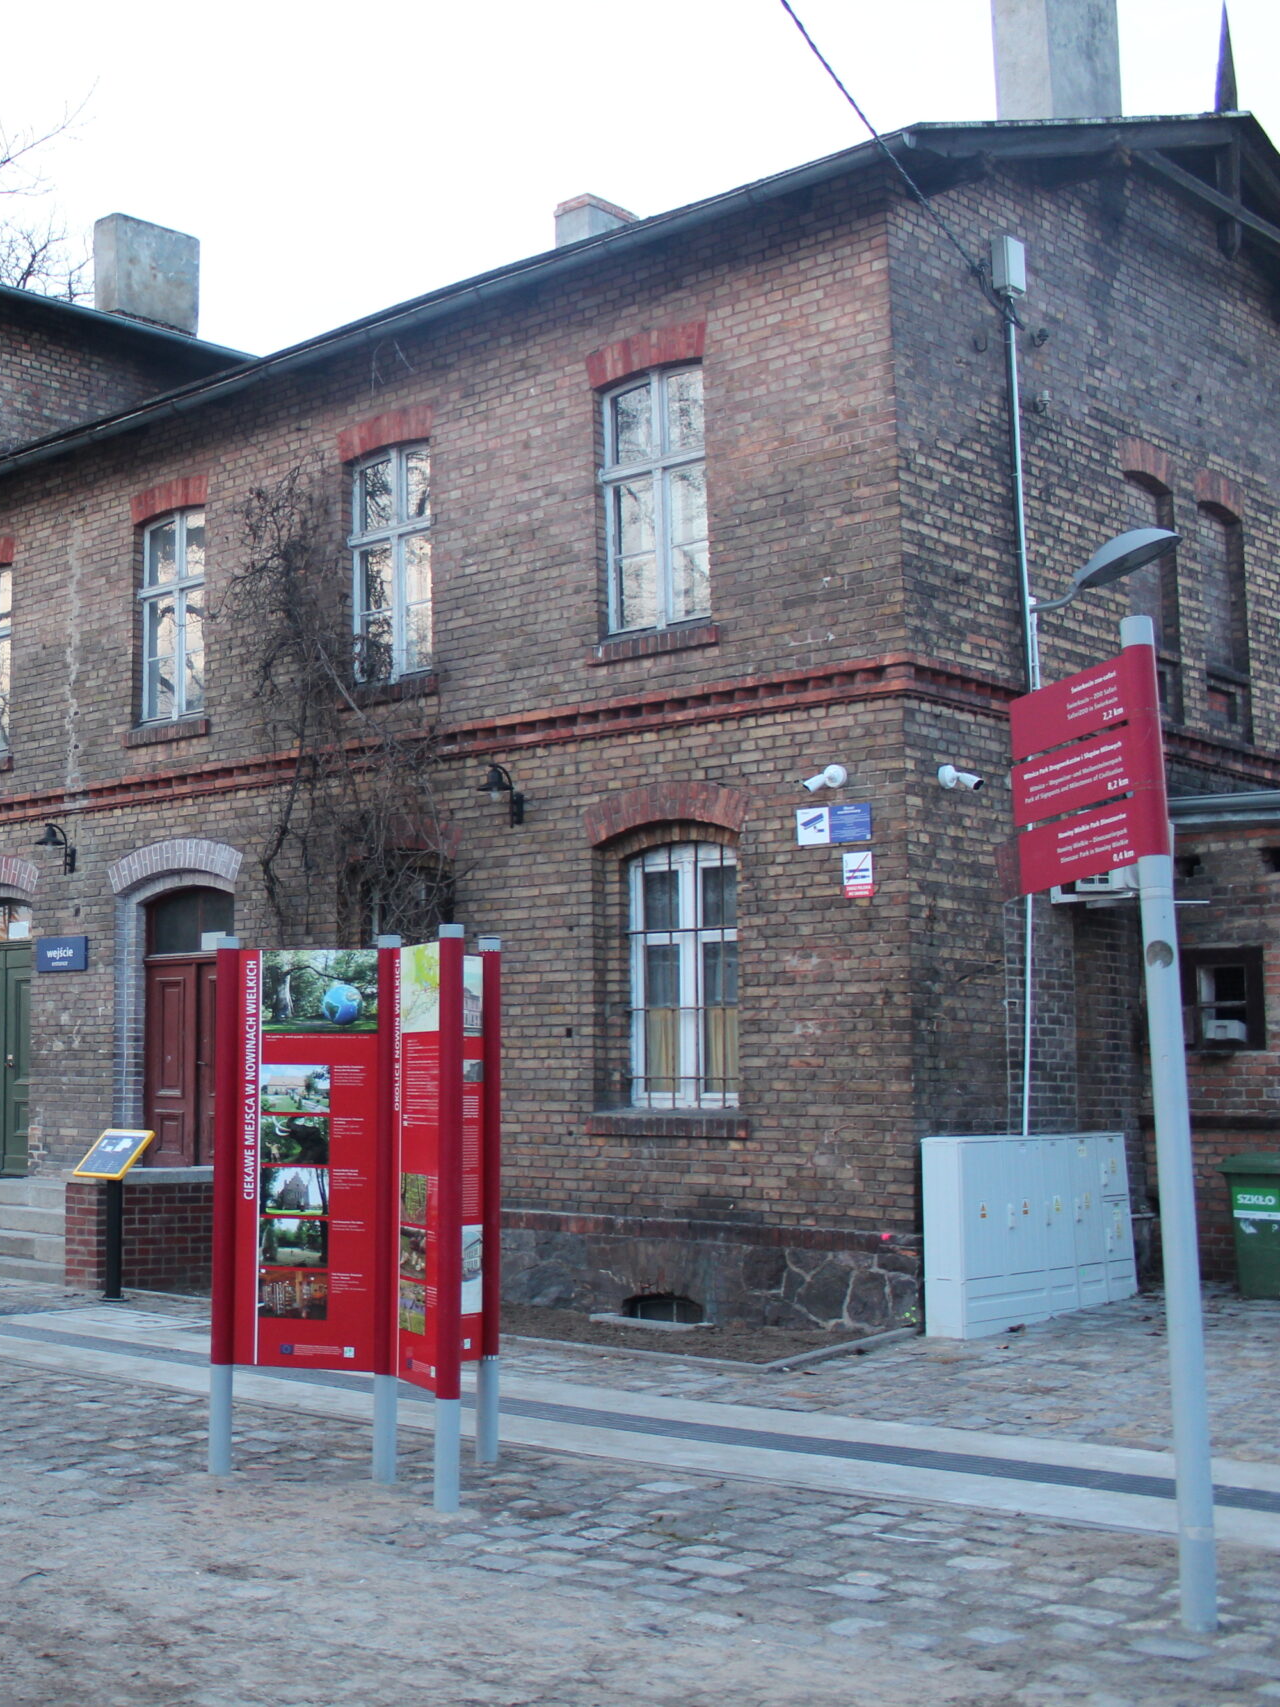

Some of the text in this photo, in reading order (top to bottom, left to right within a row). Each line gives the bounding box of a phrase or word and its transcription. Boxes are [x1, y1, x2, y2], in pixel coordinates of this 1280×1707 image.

[1103, 707, 1124, 721] 2,2 km
[1118, 778, 1129, 787] km
[1123, 850, 1134, 859] km
[46, 946, 74, 960] wejście
[243, 960, 257, 1200] CIEKAWE MIEJSCA W NOWINACH WIELKICH
[1236, 1194, 1276, 1205] SZKŁO
